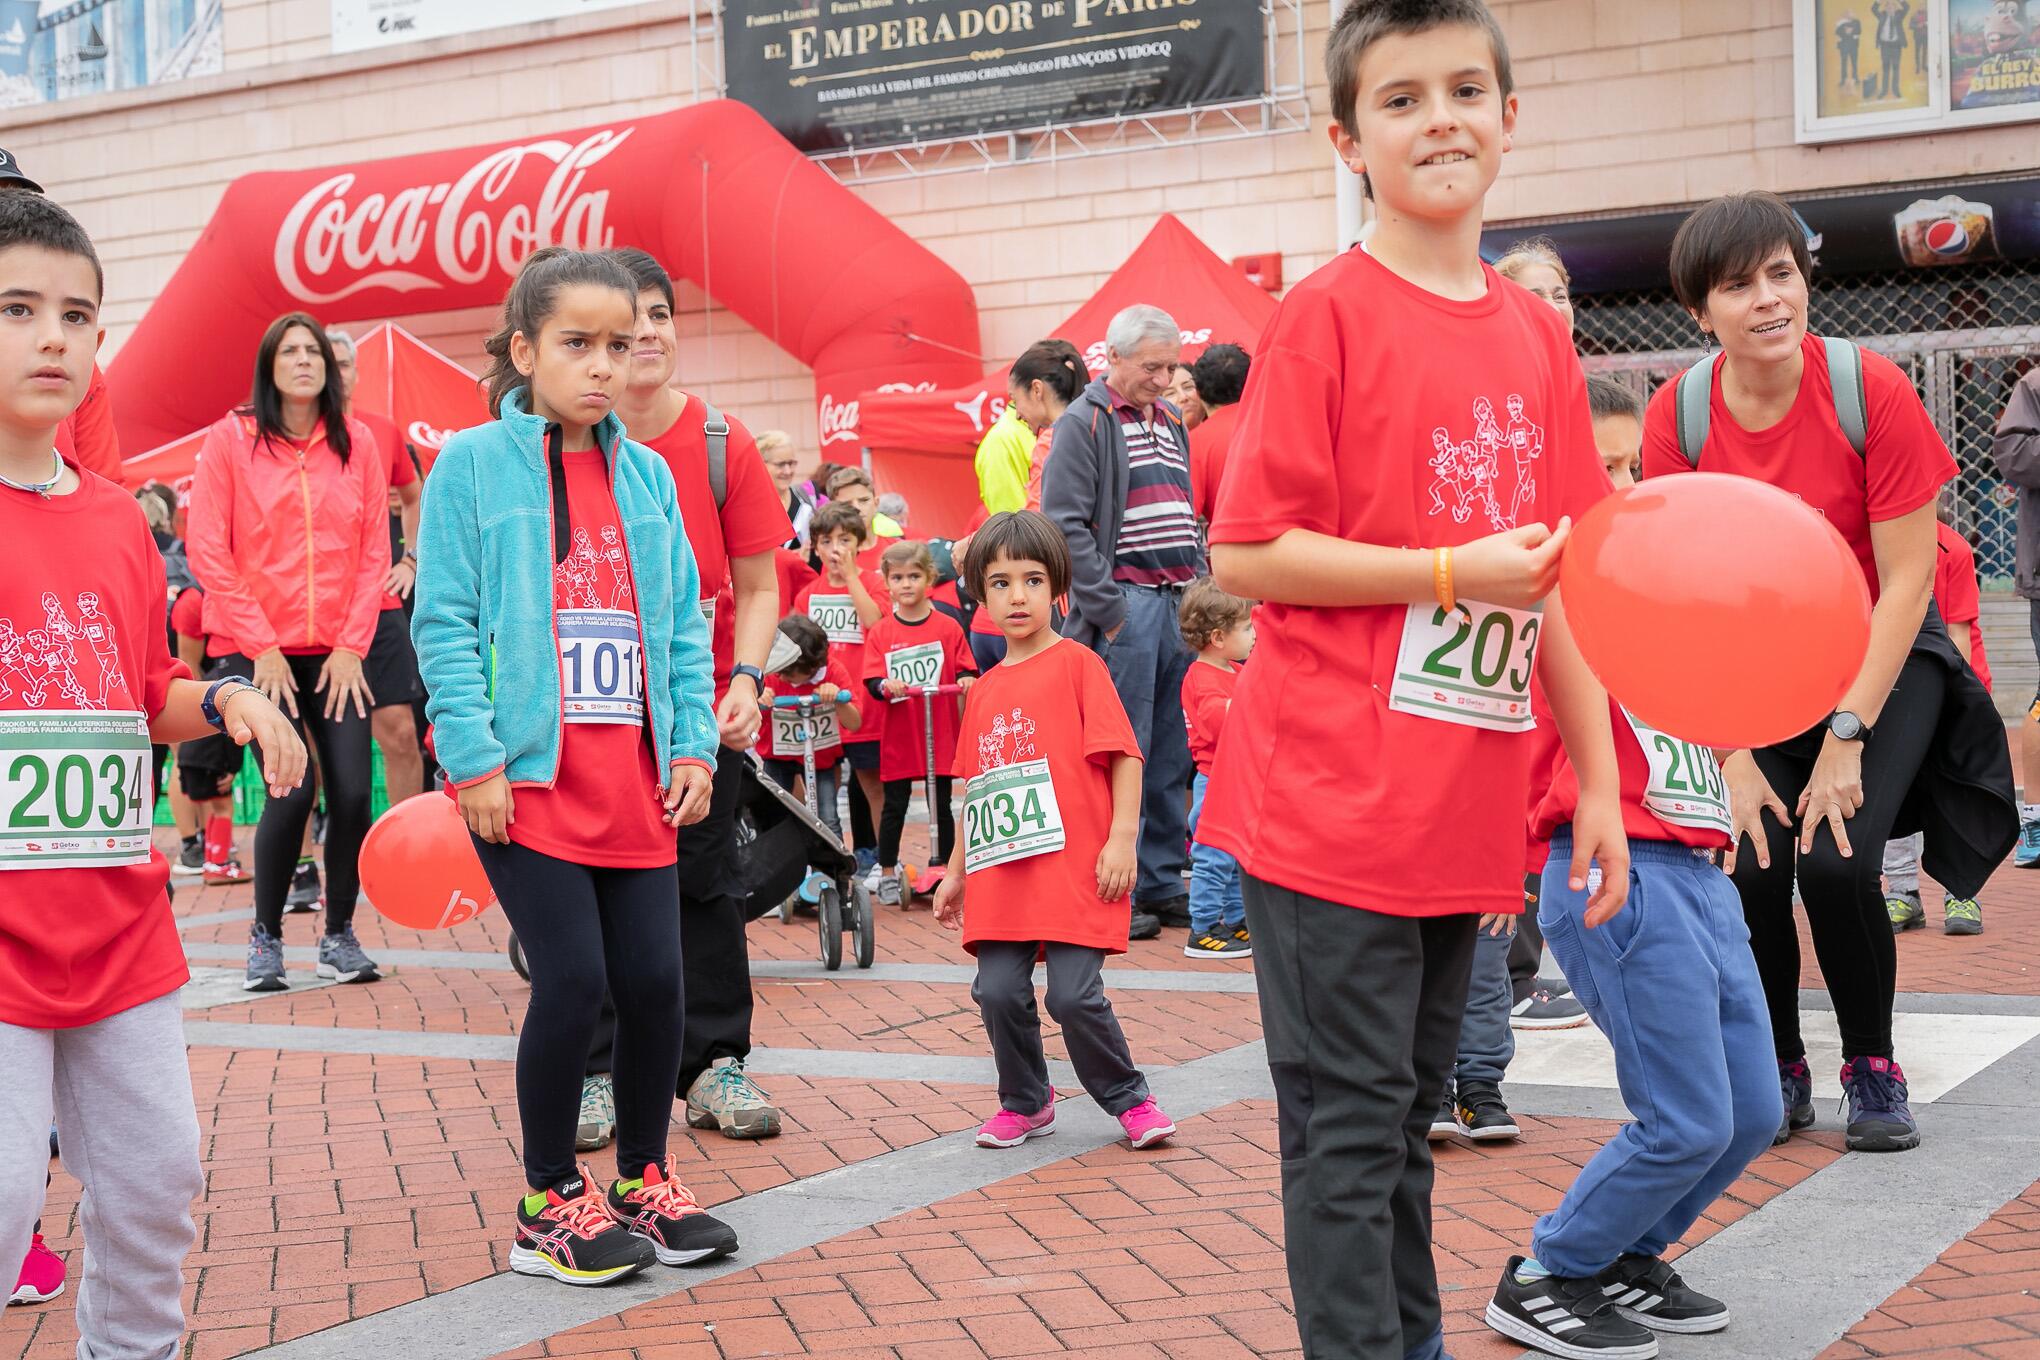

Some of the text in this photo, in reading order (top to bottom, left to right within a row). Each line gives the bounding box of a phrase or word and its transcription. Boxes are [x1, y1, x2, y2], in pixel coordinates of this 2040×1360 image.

[789, 3, 1034, 70] EMPERADOR
[1041, 1, 1065, 18] DE
[1054, 50, 1118, 69] FRANÇOIS
[1120, 40, 1172, 60] VIDOCQ
[274, 126, 636, 304] Coca-Cola
[813, 608, 858, 630] 2004
[8, 754, 143, 829] 2034
[1653, 734, 1725, 801] 203
[967, 788, 1047, 849] 2034
